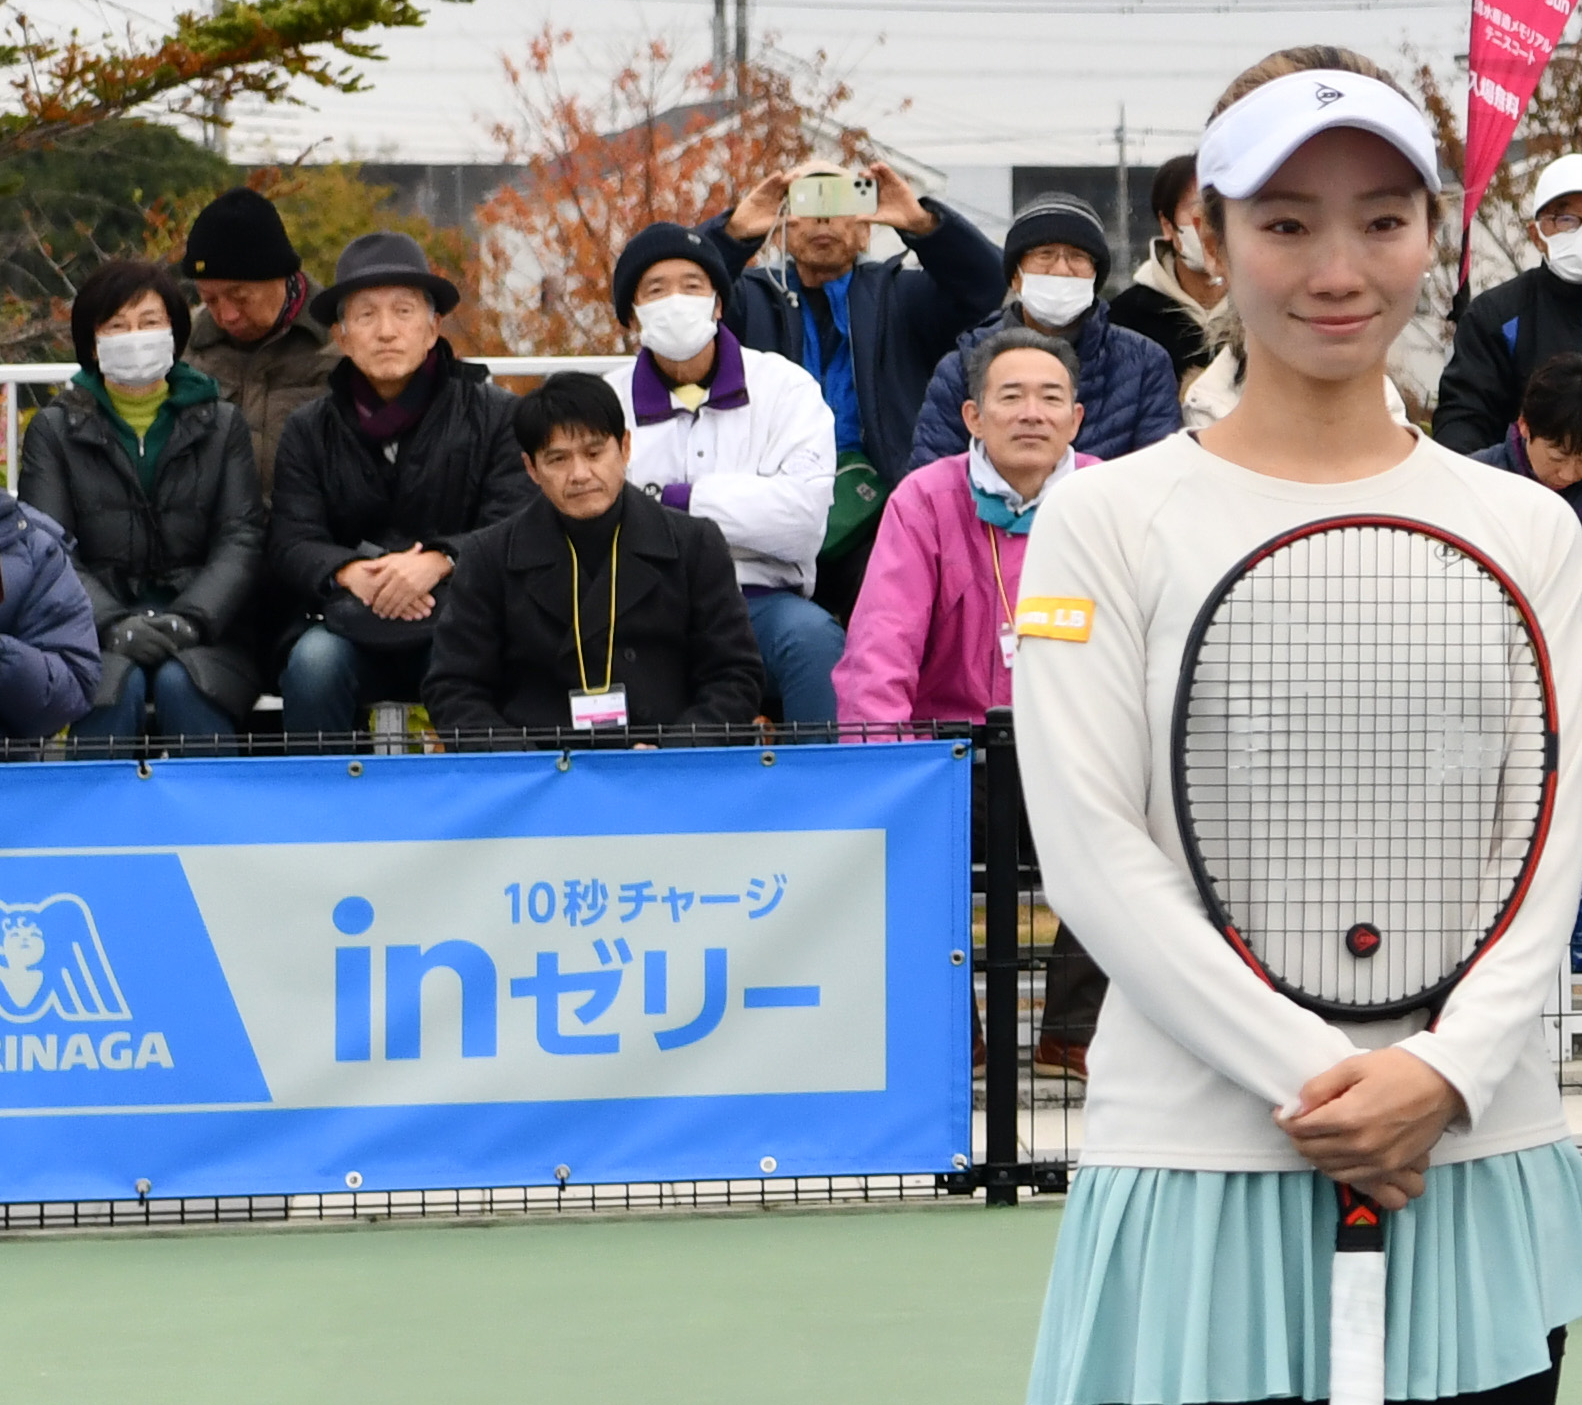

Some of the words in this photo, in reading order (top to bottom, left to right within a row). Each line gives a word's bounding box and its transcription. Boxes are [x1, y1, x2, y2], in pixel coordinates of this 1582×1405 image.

[1485, 25, 1536, 66] テニスコート
[503, 873, 788, 928] 10秒チャージ
[331, 895, 821, 1064] inゼリー
[0, 1031, 174, 1072] INAGA
